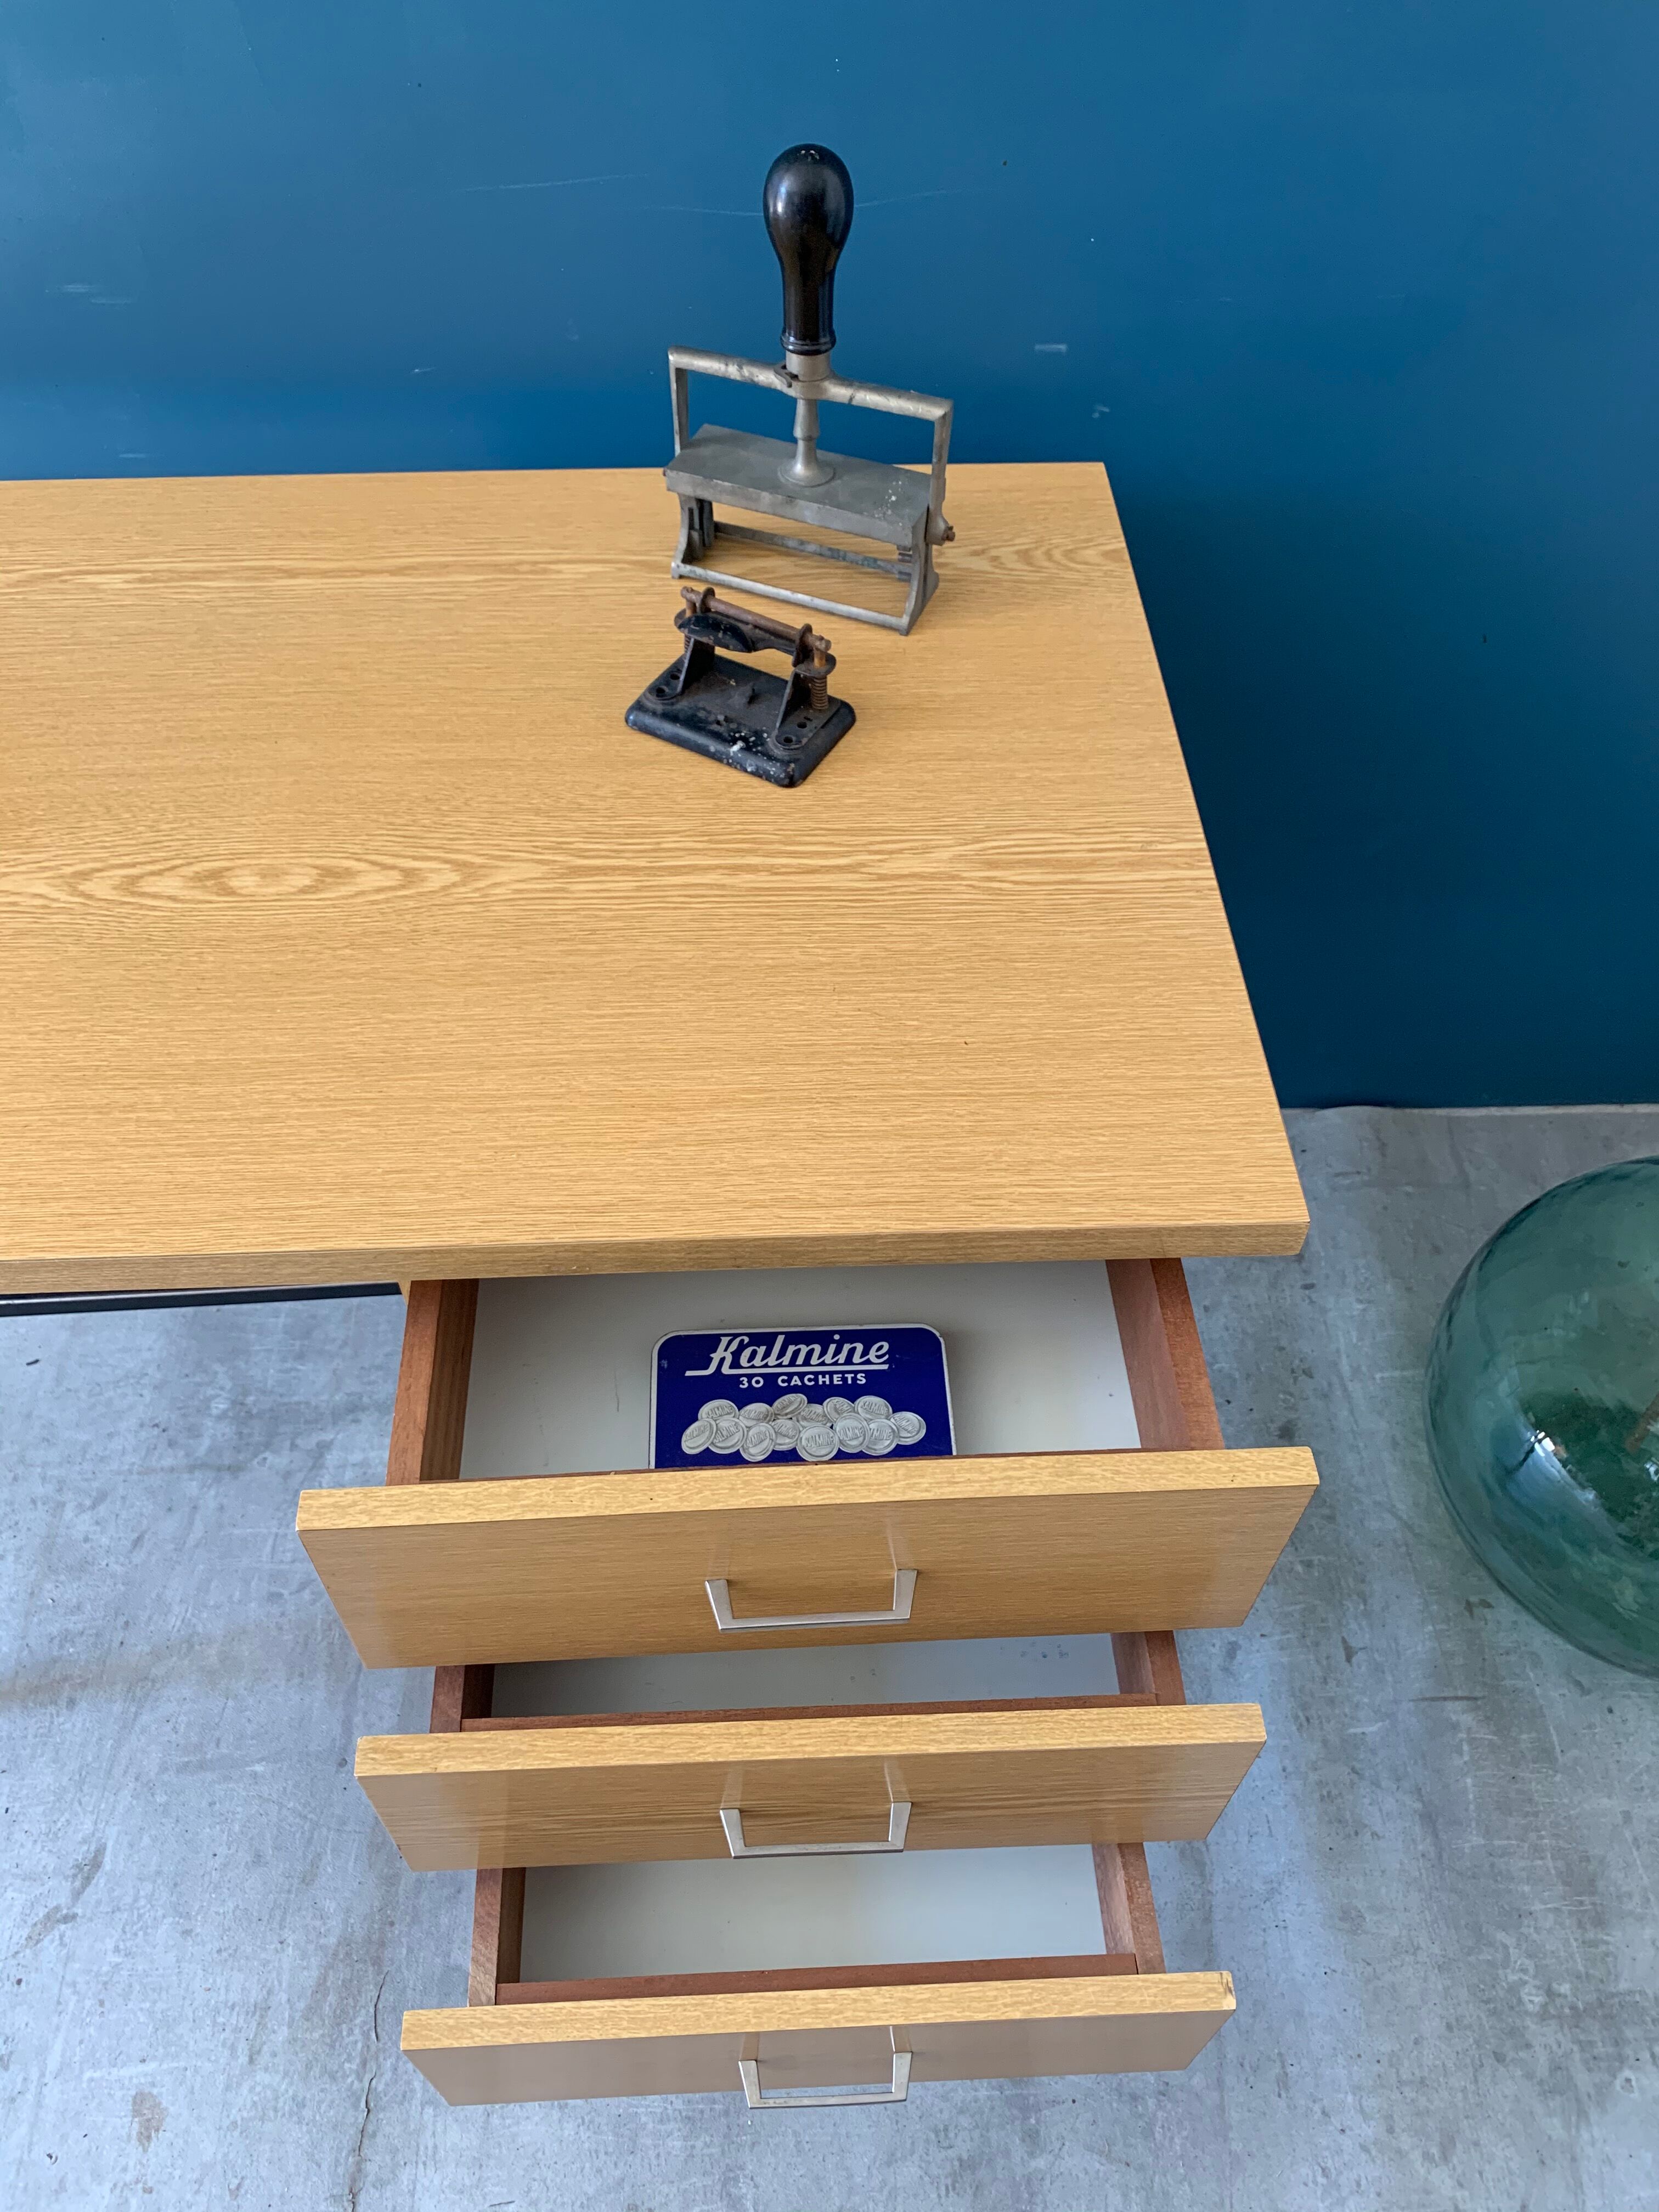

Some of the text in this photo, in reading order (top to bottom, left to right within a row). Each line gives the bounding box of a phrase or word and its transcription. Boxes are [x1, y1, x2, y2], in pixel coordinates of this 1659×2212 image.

[685, 1334, 889, 1375] Kalmine
[739, 1373, 867, 1389] 30 CACHETS
